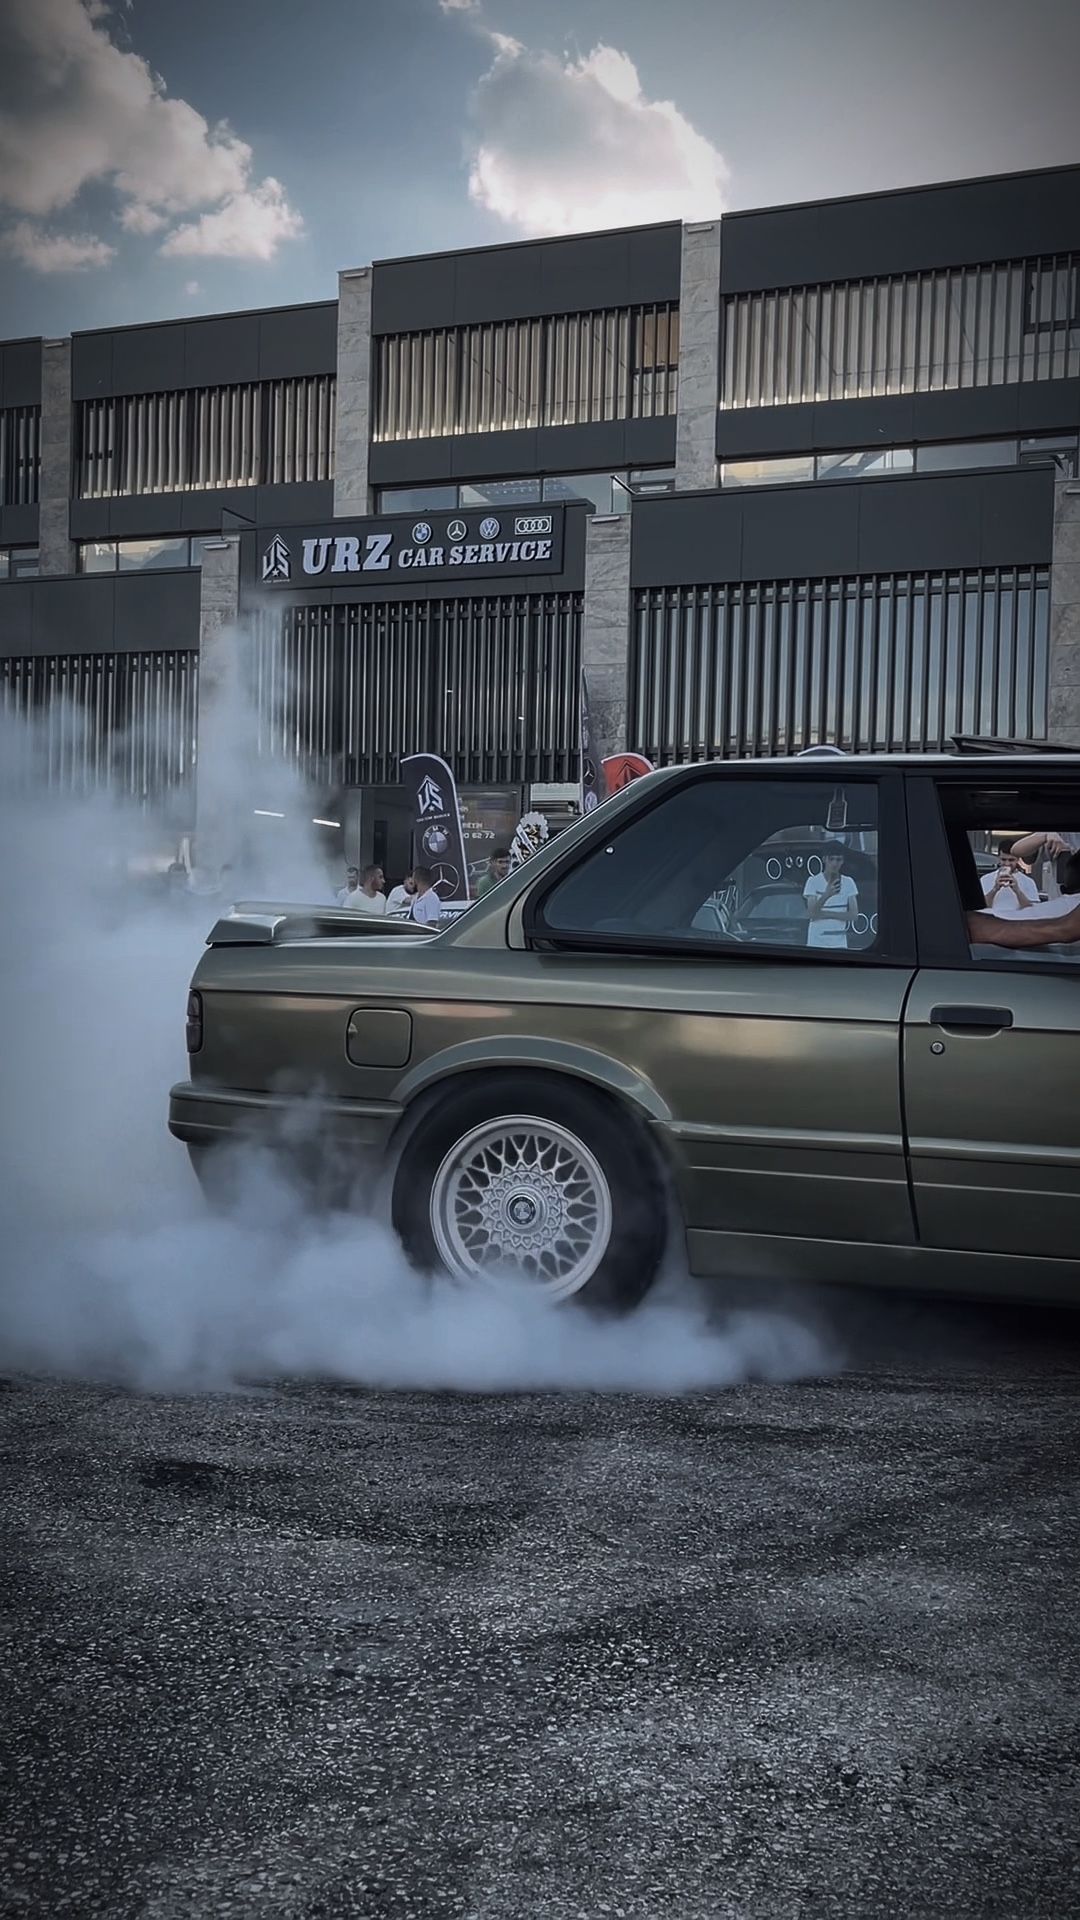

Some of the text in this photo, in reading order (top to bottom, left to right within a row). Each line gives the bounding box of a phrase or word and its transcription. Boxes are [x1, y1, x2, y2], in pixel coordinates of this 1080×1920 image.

[302, 533, 393, 574] URZ
[398, 540, 552, 568] CAR SERVICE
